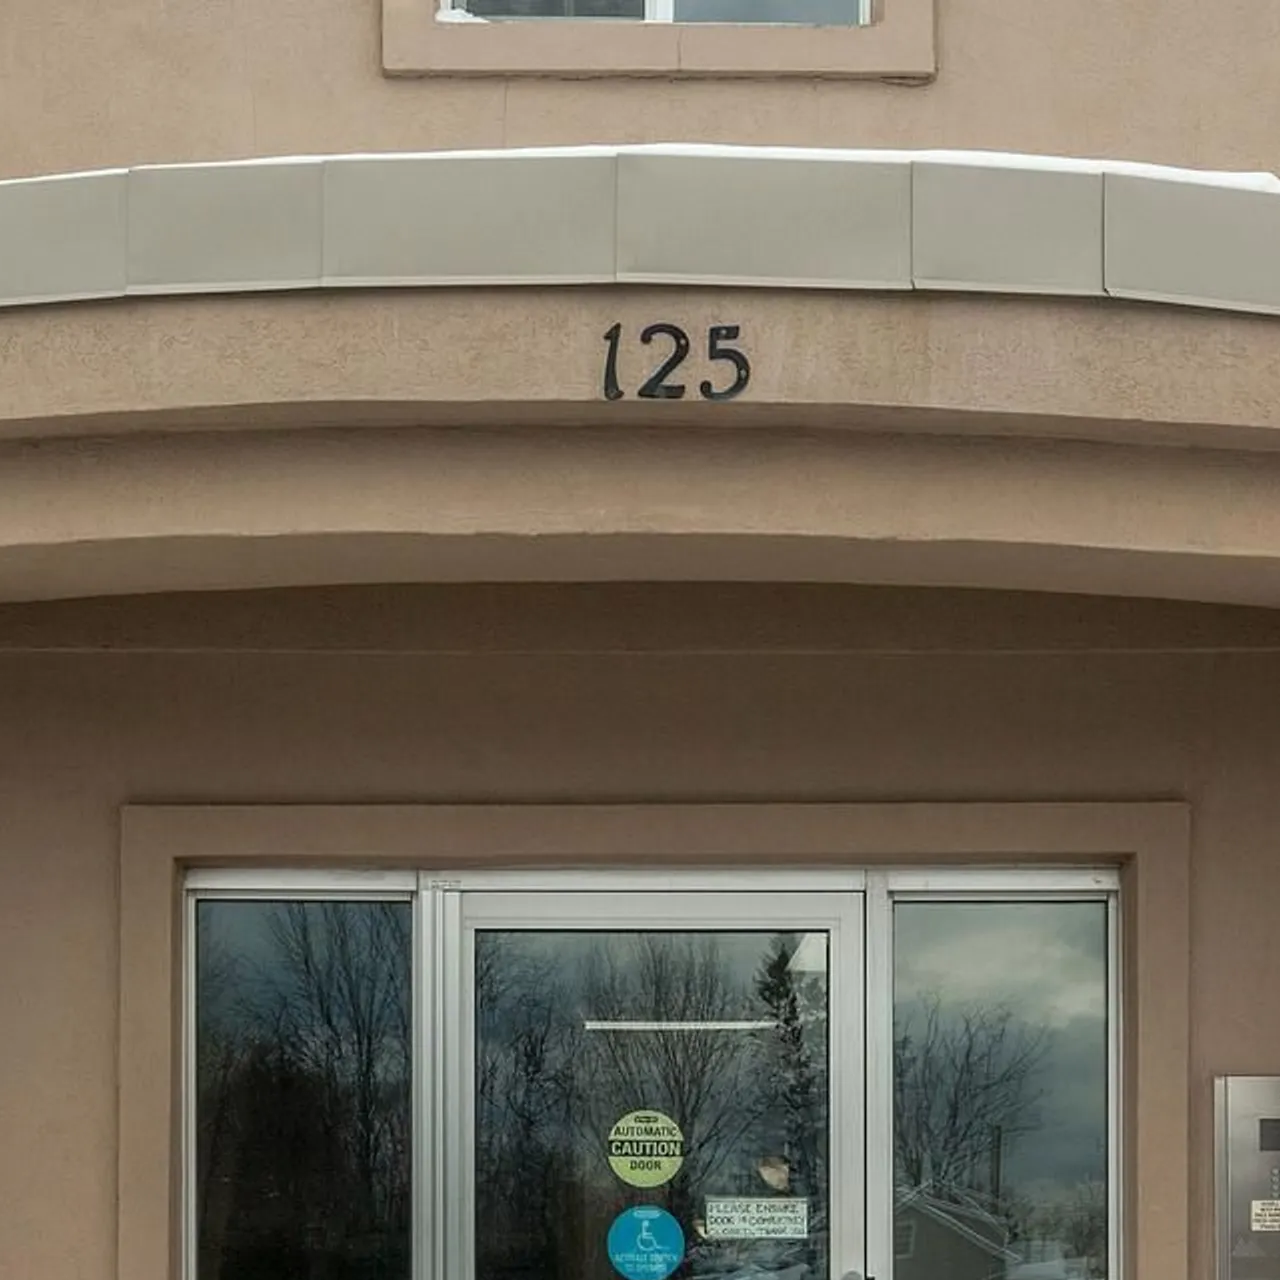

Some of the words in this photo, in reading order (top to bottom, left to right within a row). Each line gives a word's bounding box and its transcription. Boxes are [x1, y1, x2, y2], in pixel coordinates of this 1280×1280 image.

[603, 323, 751, 400] 125
[614, 1126, 678, 1137] AUTOMATIC
[611, 1141, 681, 1155] CAUTION
[629, 1160, 662, 1171] DOOR
[708, 1203, 751, 1213] PLEASE
